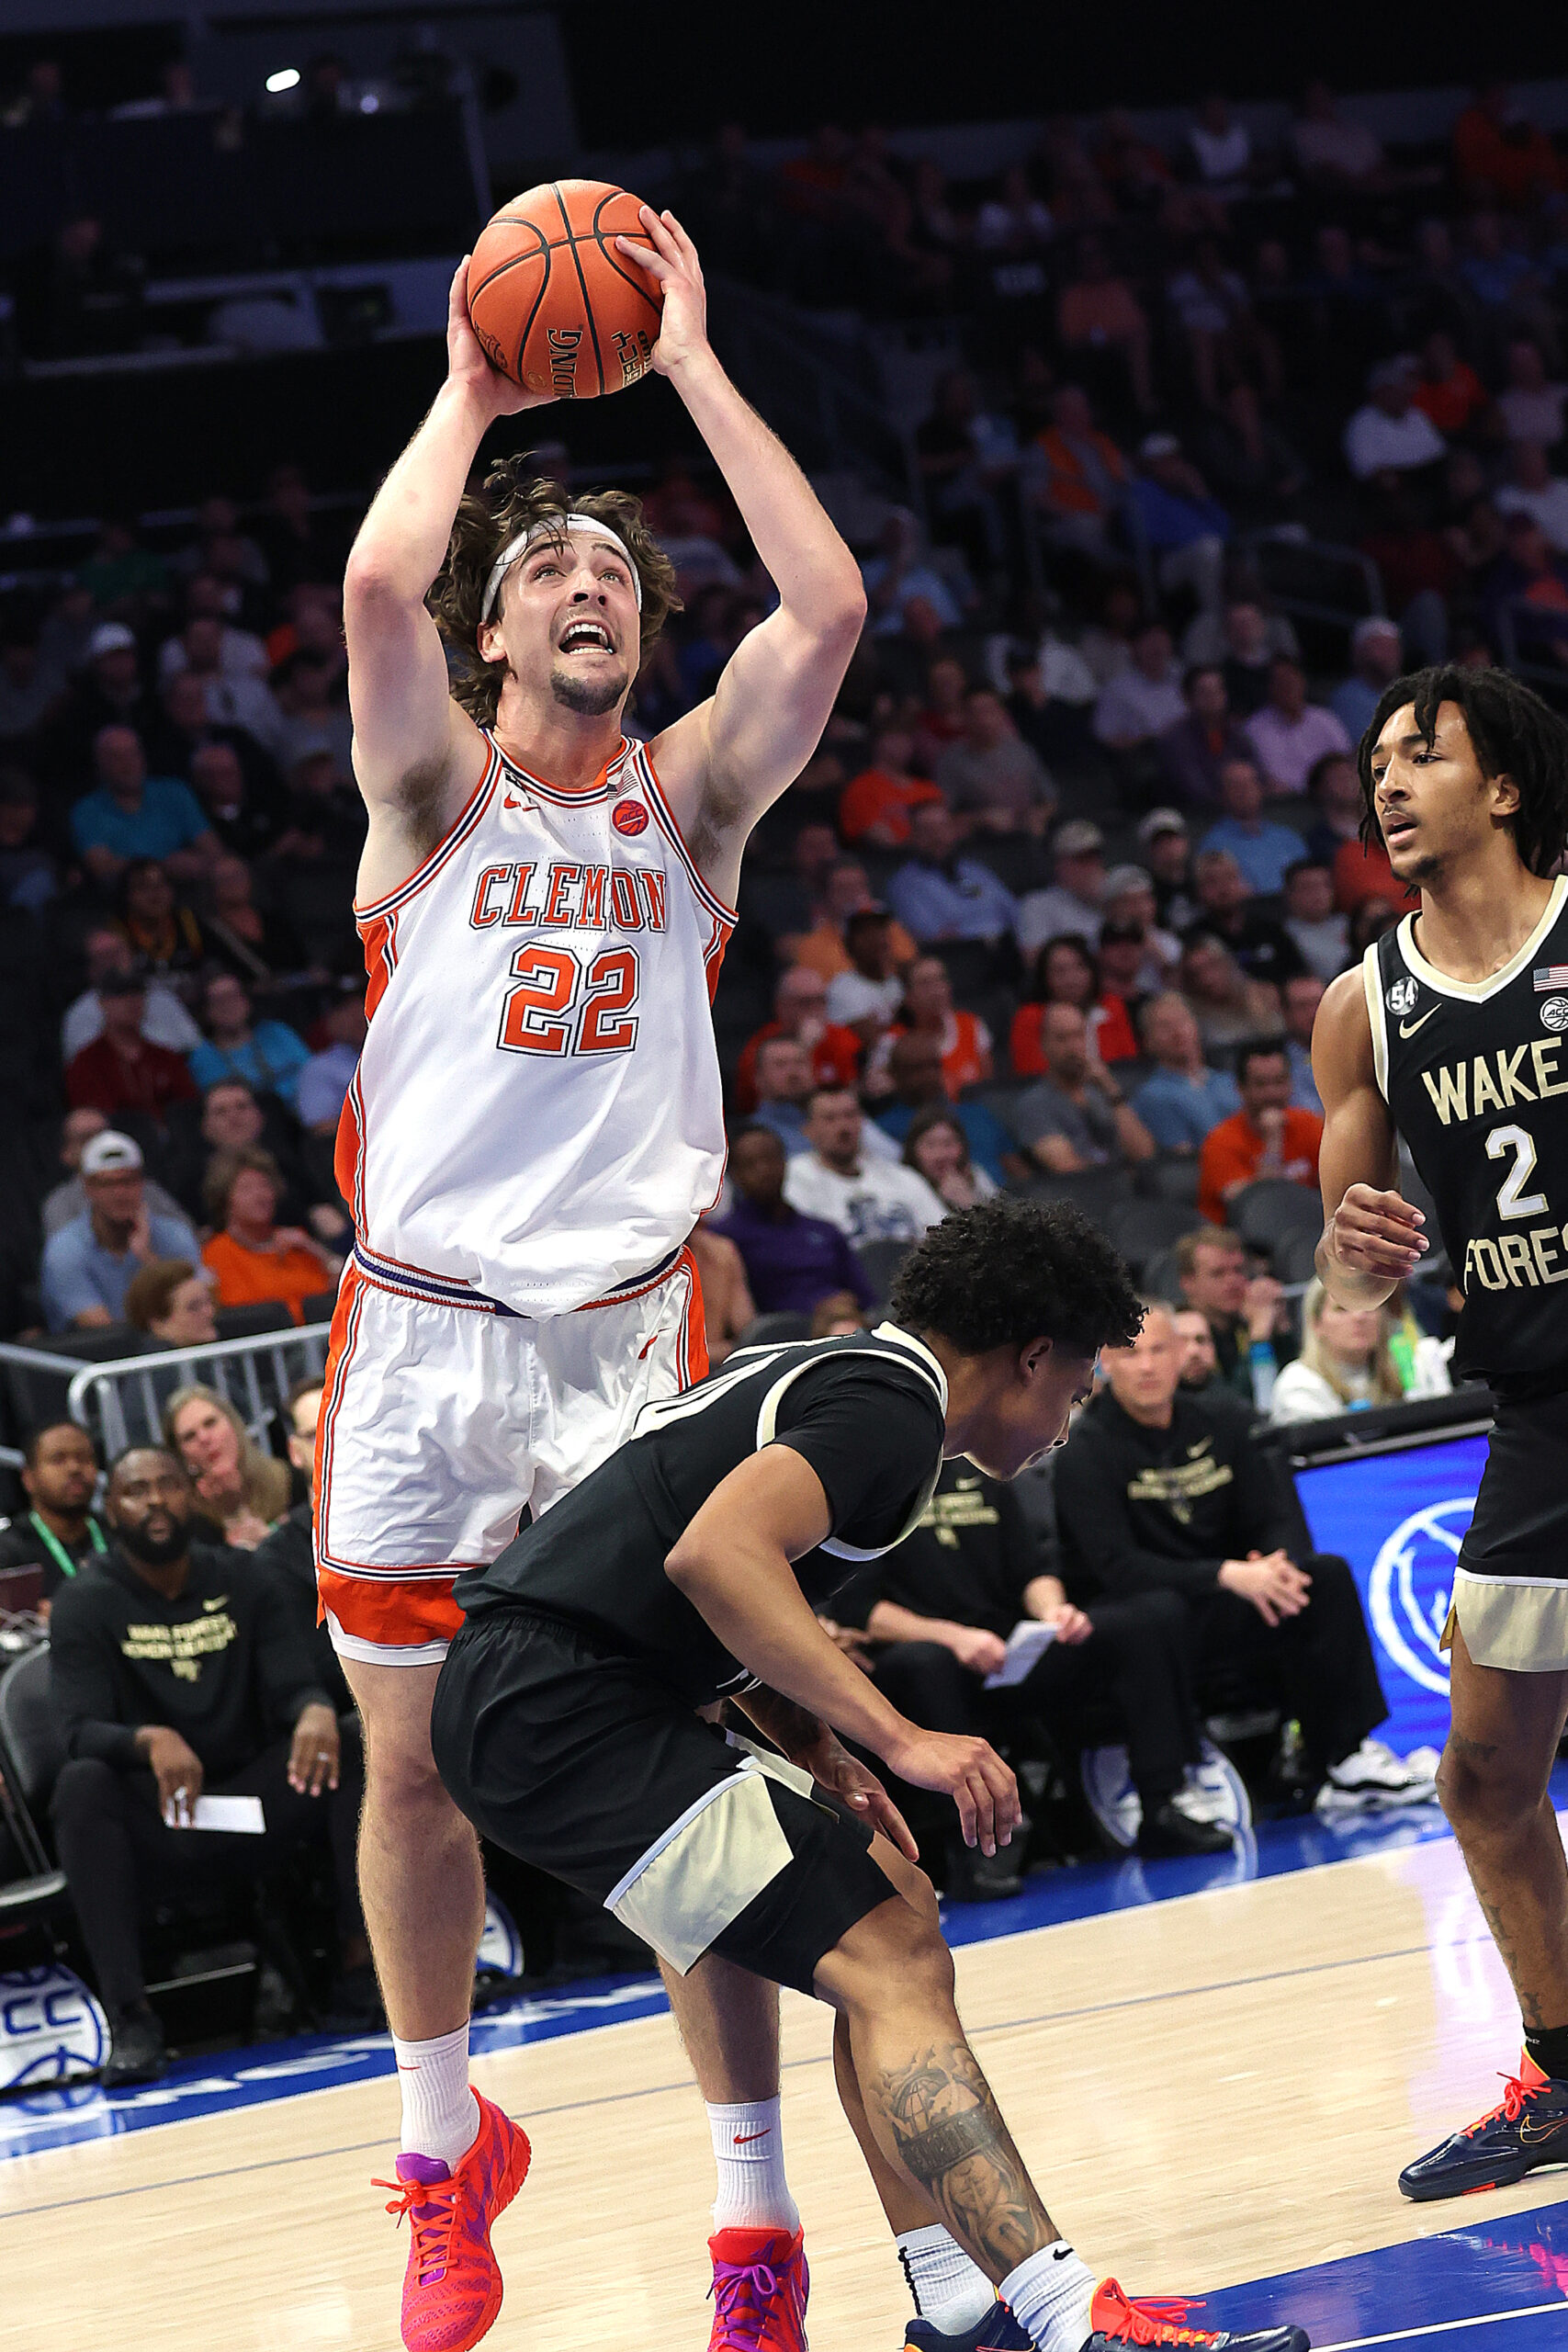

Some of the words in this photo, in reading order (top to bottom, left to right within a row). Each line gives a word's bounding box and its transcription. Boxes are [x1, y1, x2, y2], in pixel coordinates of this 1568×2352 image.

[469, 862, 666, 933] CLEMON
[496, 941, 639, 1057] 22
[1391, 979, 1416, 1011] 54
[1421, 1037, 1568, 1125] WAKE
[1484, 1124, 1550, 1221] 2
